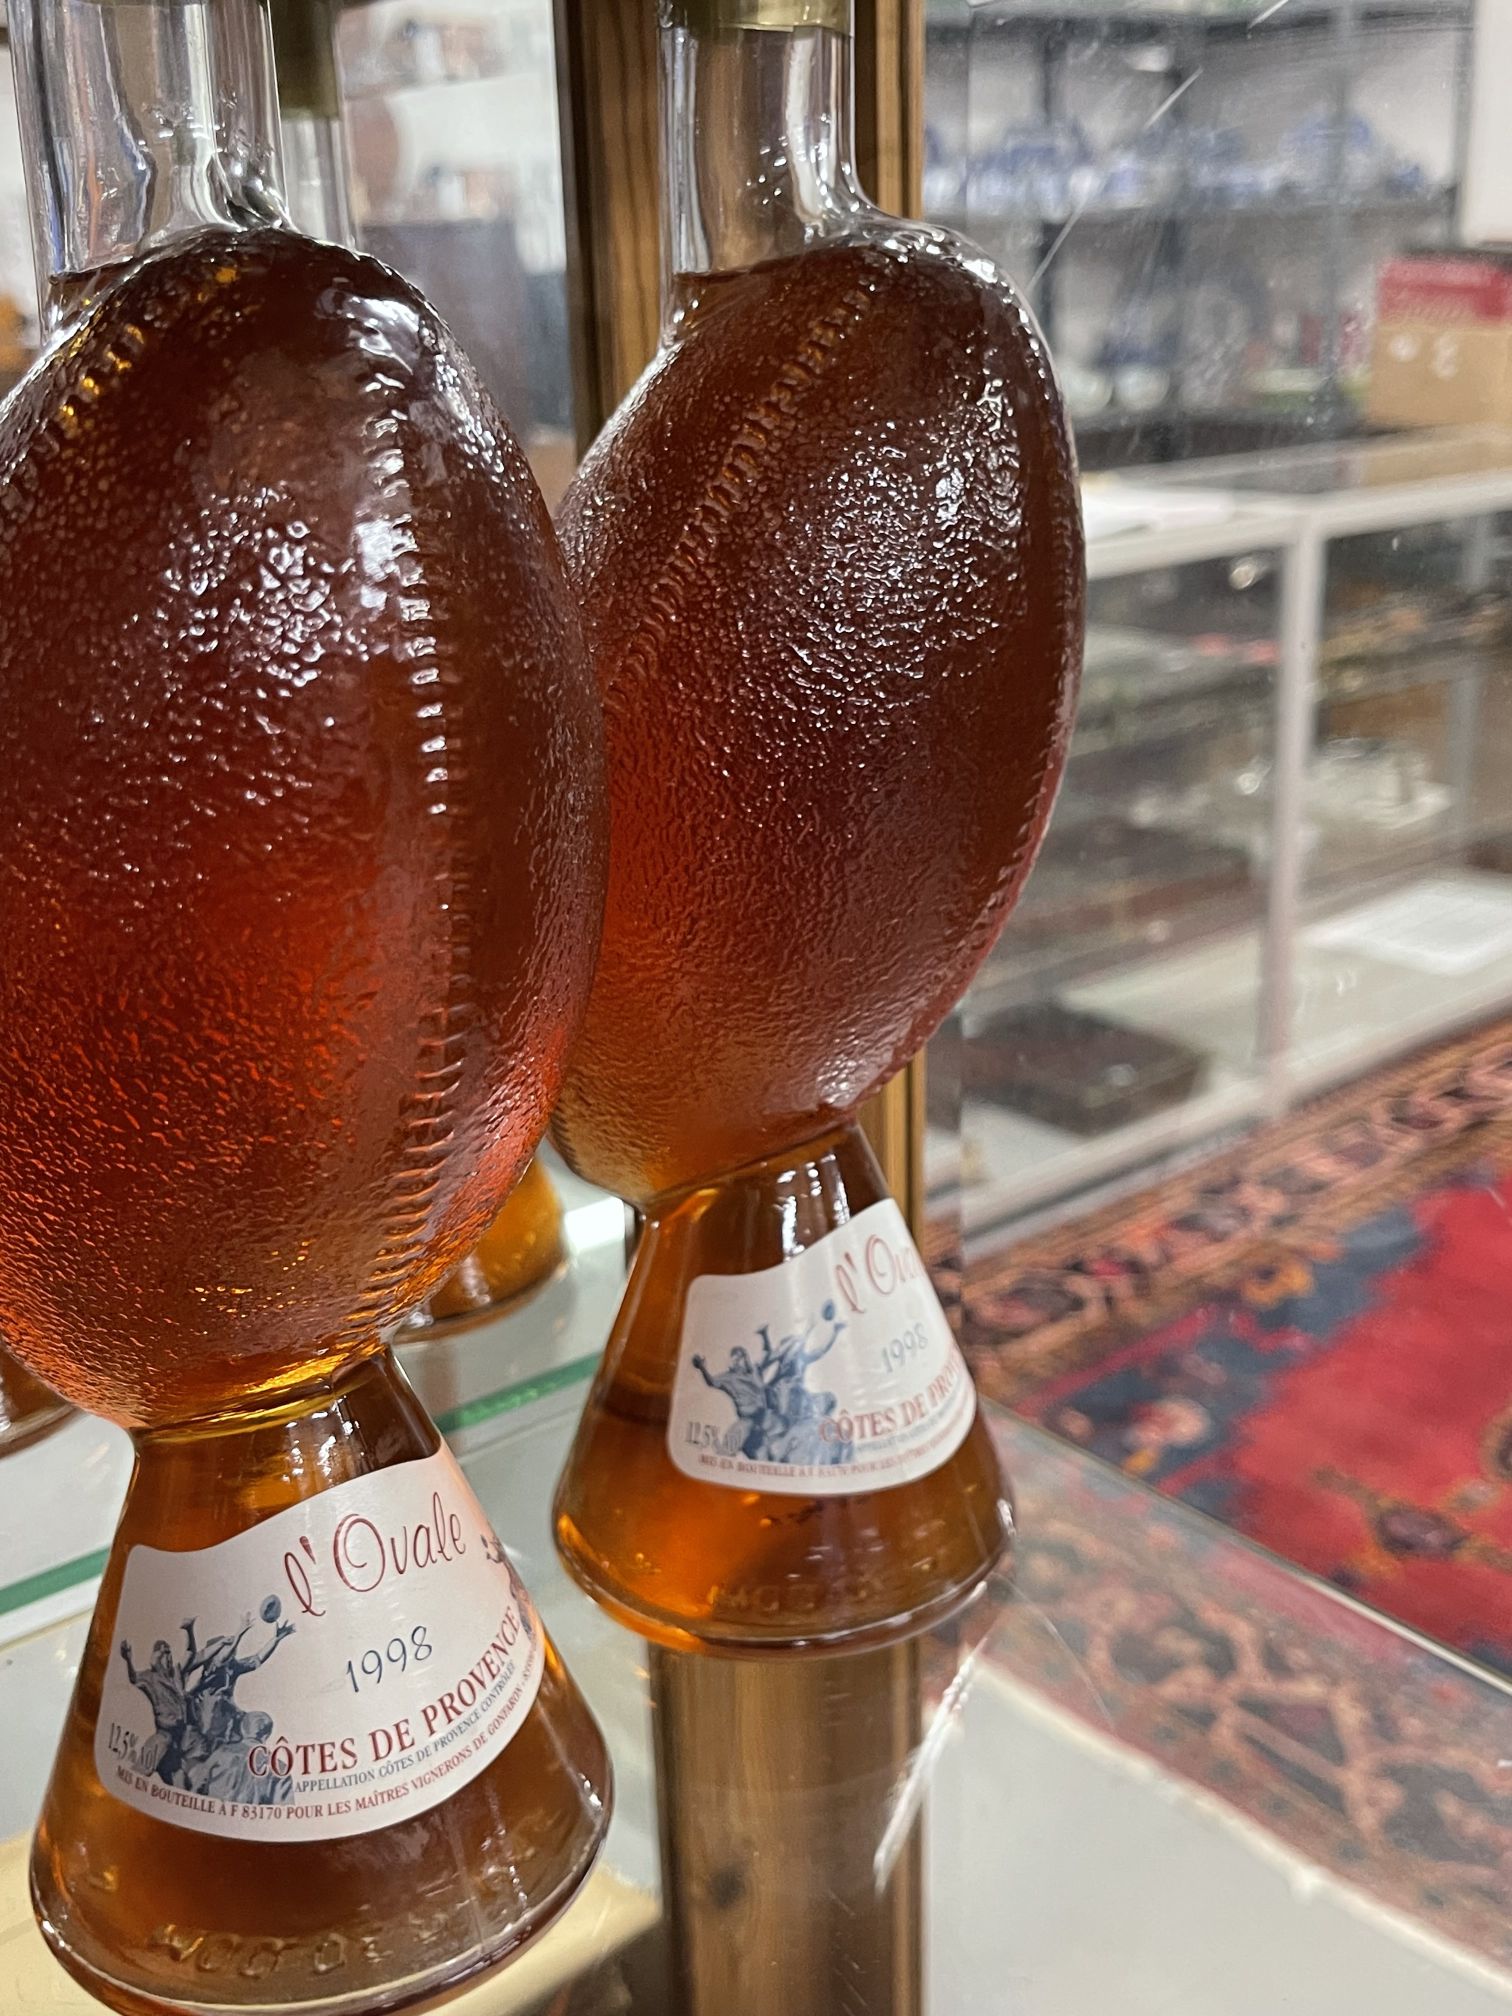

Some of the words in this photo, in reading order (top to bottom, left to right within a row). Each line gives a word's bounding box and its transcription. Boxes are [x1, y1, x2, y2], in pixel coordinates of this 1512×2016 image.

[882, 1322, 928, 1373] 1998
[284, 1492, 466, 1617] l'Ovale
[248, 1736, 358, 1777] CÔTES
[369, 1719, 415, 1762] DE
[421, 1606, 520, 1737] PROVENCE
[346, 1625, 433, 1693] 1998
[116, 1765, 133, 1785] MIS
[135, 1776, 149, 1793] EN
[151, 1786, 215, 1814] BOUTEILLE
[231, 1804, 239, 1818] F
[241, 1806, 282, 1820] 83170
[286, 1801, 324, 1819] POUR
[327, 1799, 352, 1816] LES
[355, 1781, 410, 1812] MAÎTRES
[410, 1744, 474, 1789] VIGNERONS
[472, 1731, 488, 1752] DE
[294, 1769, 376, 1793] APPELLATION
[379, 1754, 414, 1778] CÔTES
[416, 1746, 433, 1762] DE
[434, 1709, 481, 1752] PROVENCE
